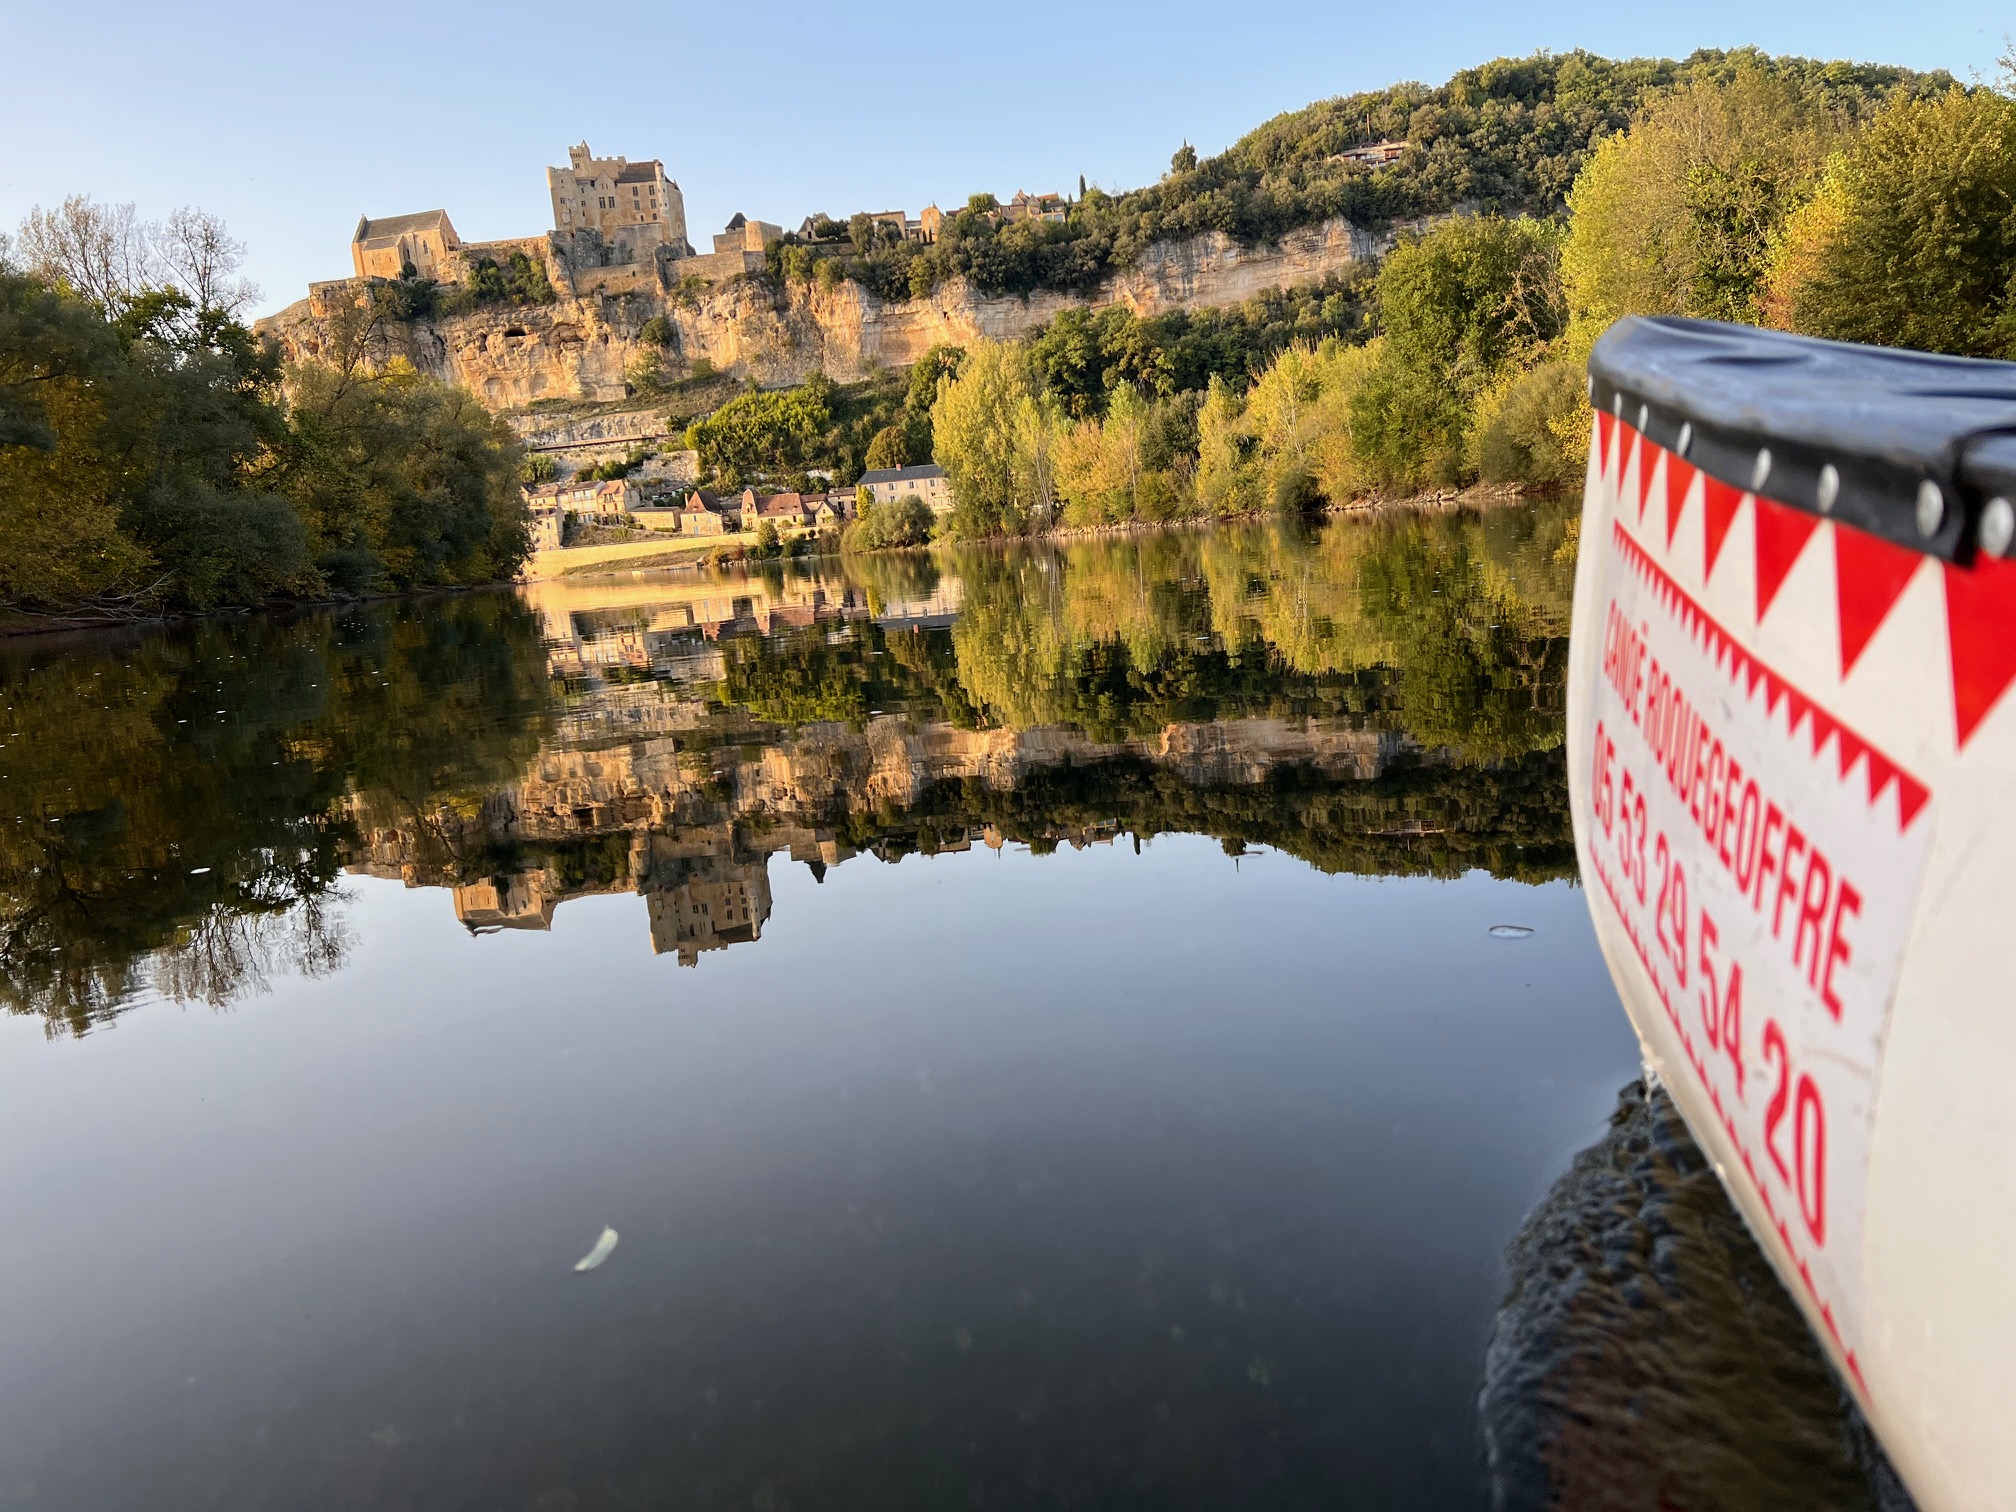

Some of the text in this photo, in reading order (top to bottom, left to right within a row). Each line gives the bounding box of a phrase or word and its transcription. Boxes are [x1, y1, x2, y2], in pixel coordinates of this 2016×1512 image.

[1592, 719, 1827, 1249] 05 53 29 54 20
[1643, 657, 1863, 1024] ROQUEGEOFFRE
